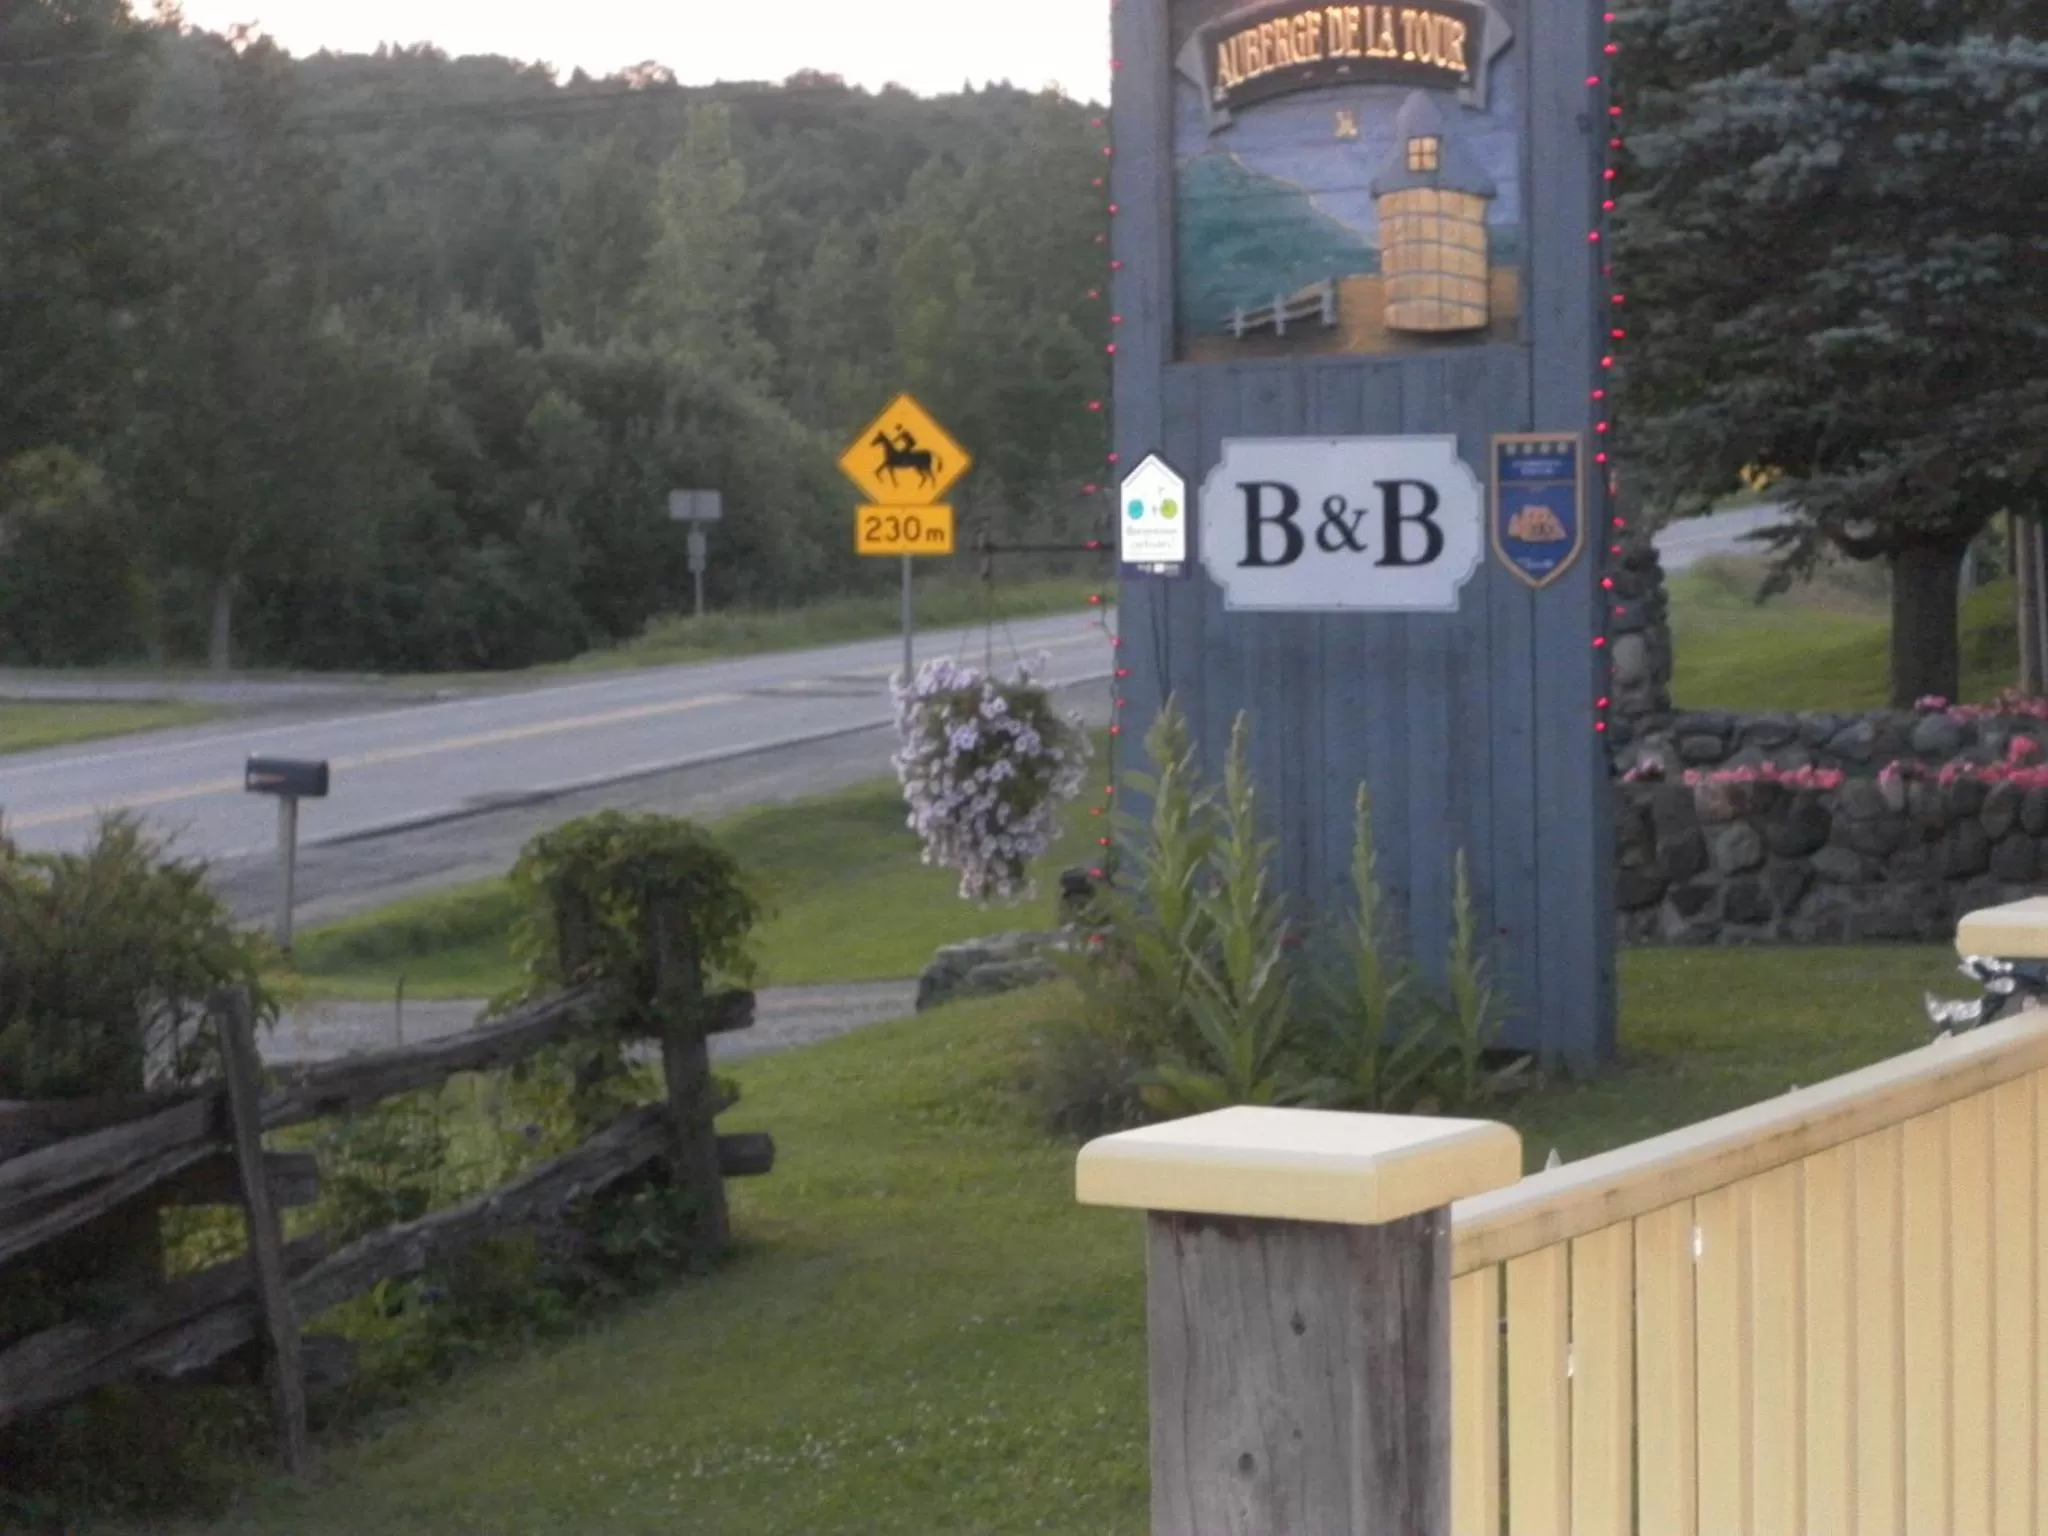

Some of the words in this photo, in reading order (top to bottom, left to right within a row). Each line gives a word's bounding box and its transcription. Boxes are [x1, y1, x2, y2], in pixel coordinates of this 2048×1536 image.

[1216, 10, 1323, 87] AUBERGE
[1325, 5, 1361, 58] DE
[1363, 5, 1398, 58] LA
[1400, 8, 1468, 72] TOUR
[864, 515, 922, 543] 230
[926, 527, 945, 542] m
[1235, 478, 1445, 568] B&B
